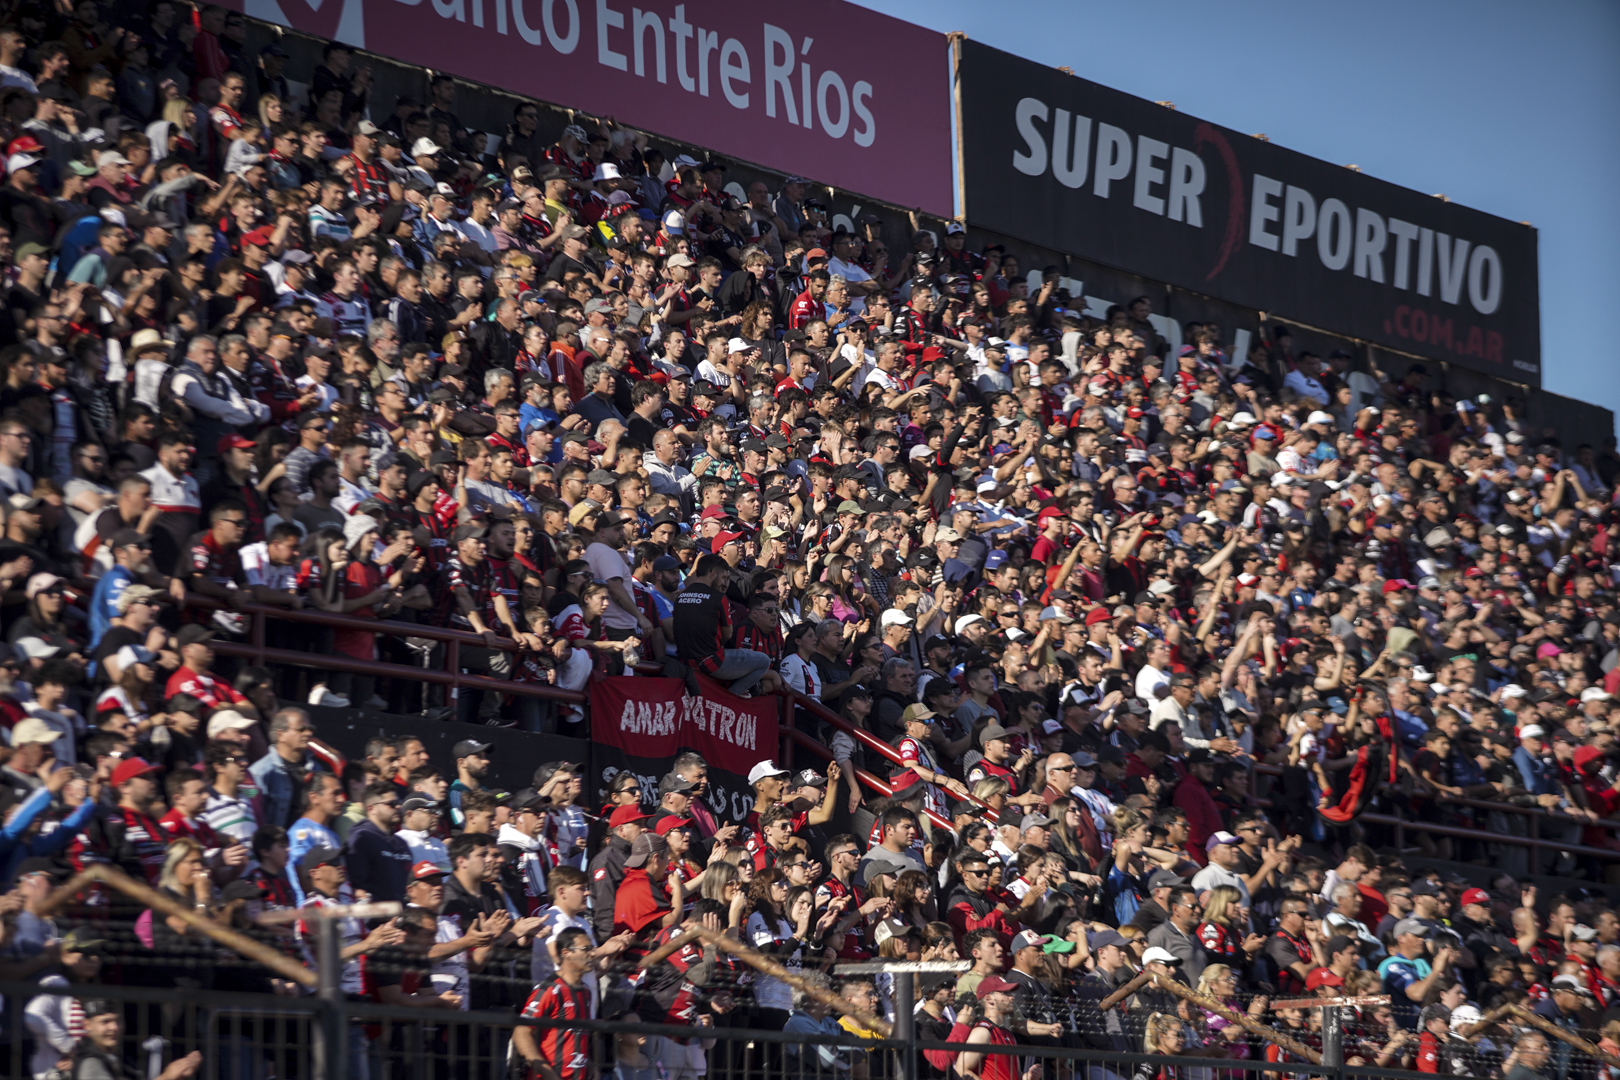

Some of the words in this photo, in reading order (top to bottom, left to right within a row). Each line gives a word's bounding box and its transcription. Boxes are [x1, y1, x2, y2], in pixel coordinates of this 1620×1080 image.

[597, 0, 751, 109] Entre
[764, 22, 876, 147] Ríos
[1012, 97, 1206, 228] SUPER
